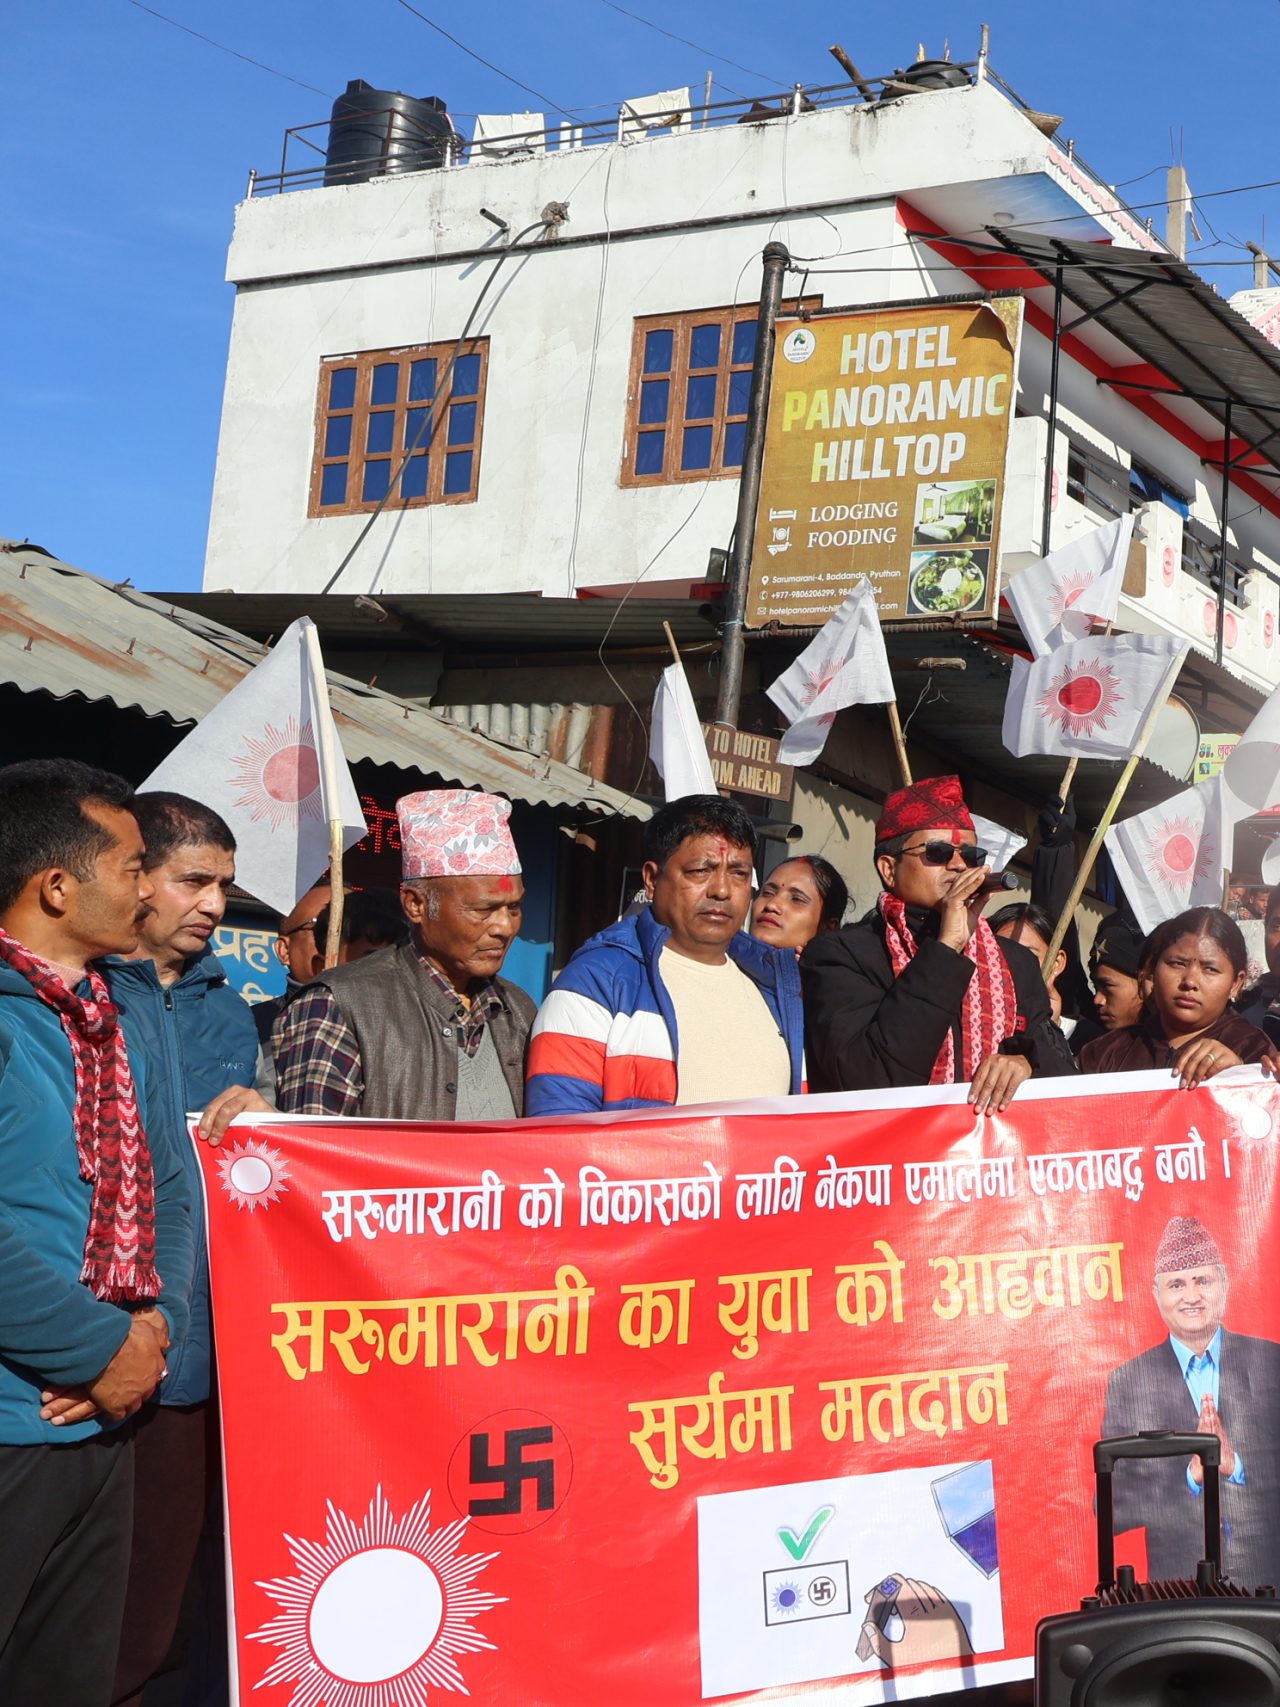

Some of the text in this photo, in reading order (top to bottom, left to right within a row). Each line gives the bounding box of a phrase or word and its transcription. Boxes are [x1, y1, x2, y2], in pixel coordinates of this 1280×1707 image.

[840, 326, 957, 375] HOTEL
[782, 374, 1007, 432] PANORAMIC
[811, 432, 966, 483] HILLTOP
[809, 502, 899, 523] LODGING
[807, 528, 897, 548] FOODING
[869, 570, 901, 579] Pyuthan
[713, 728, 730, 754] TO
[733, 731, 772, 764] HOTEL
[737, 764, 781, 795] AHEAD
[519, 1168, 565, 1228] को
[579, 1160, 723, 1227] विकासको
[735, 1156, 806, 1220] लागि
[814, 1154, 892, 1210] नेकपा
[618, 1278, 696, 1349] का
[717, 1268, 813, 1360] युवा
[834, 1239, 906, 1327] को
[818, 1363, 1009, 1444] मतदान
